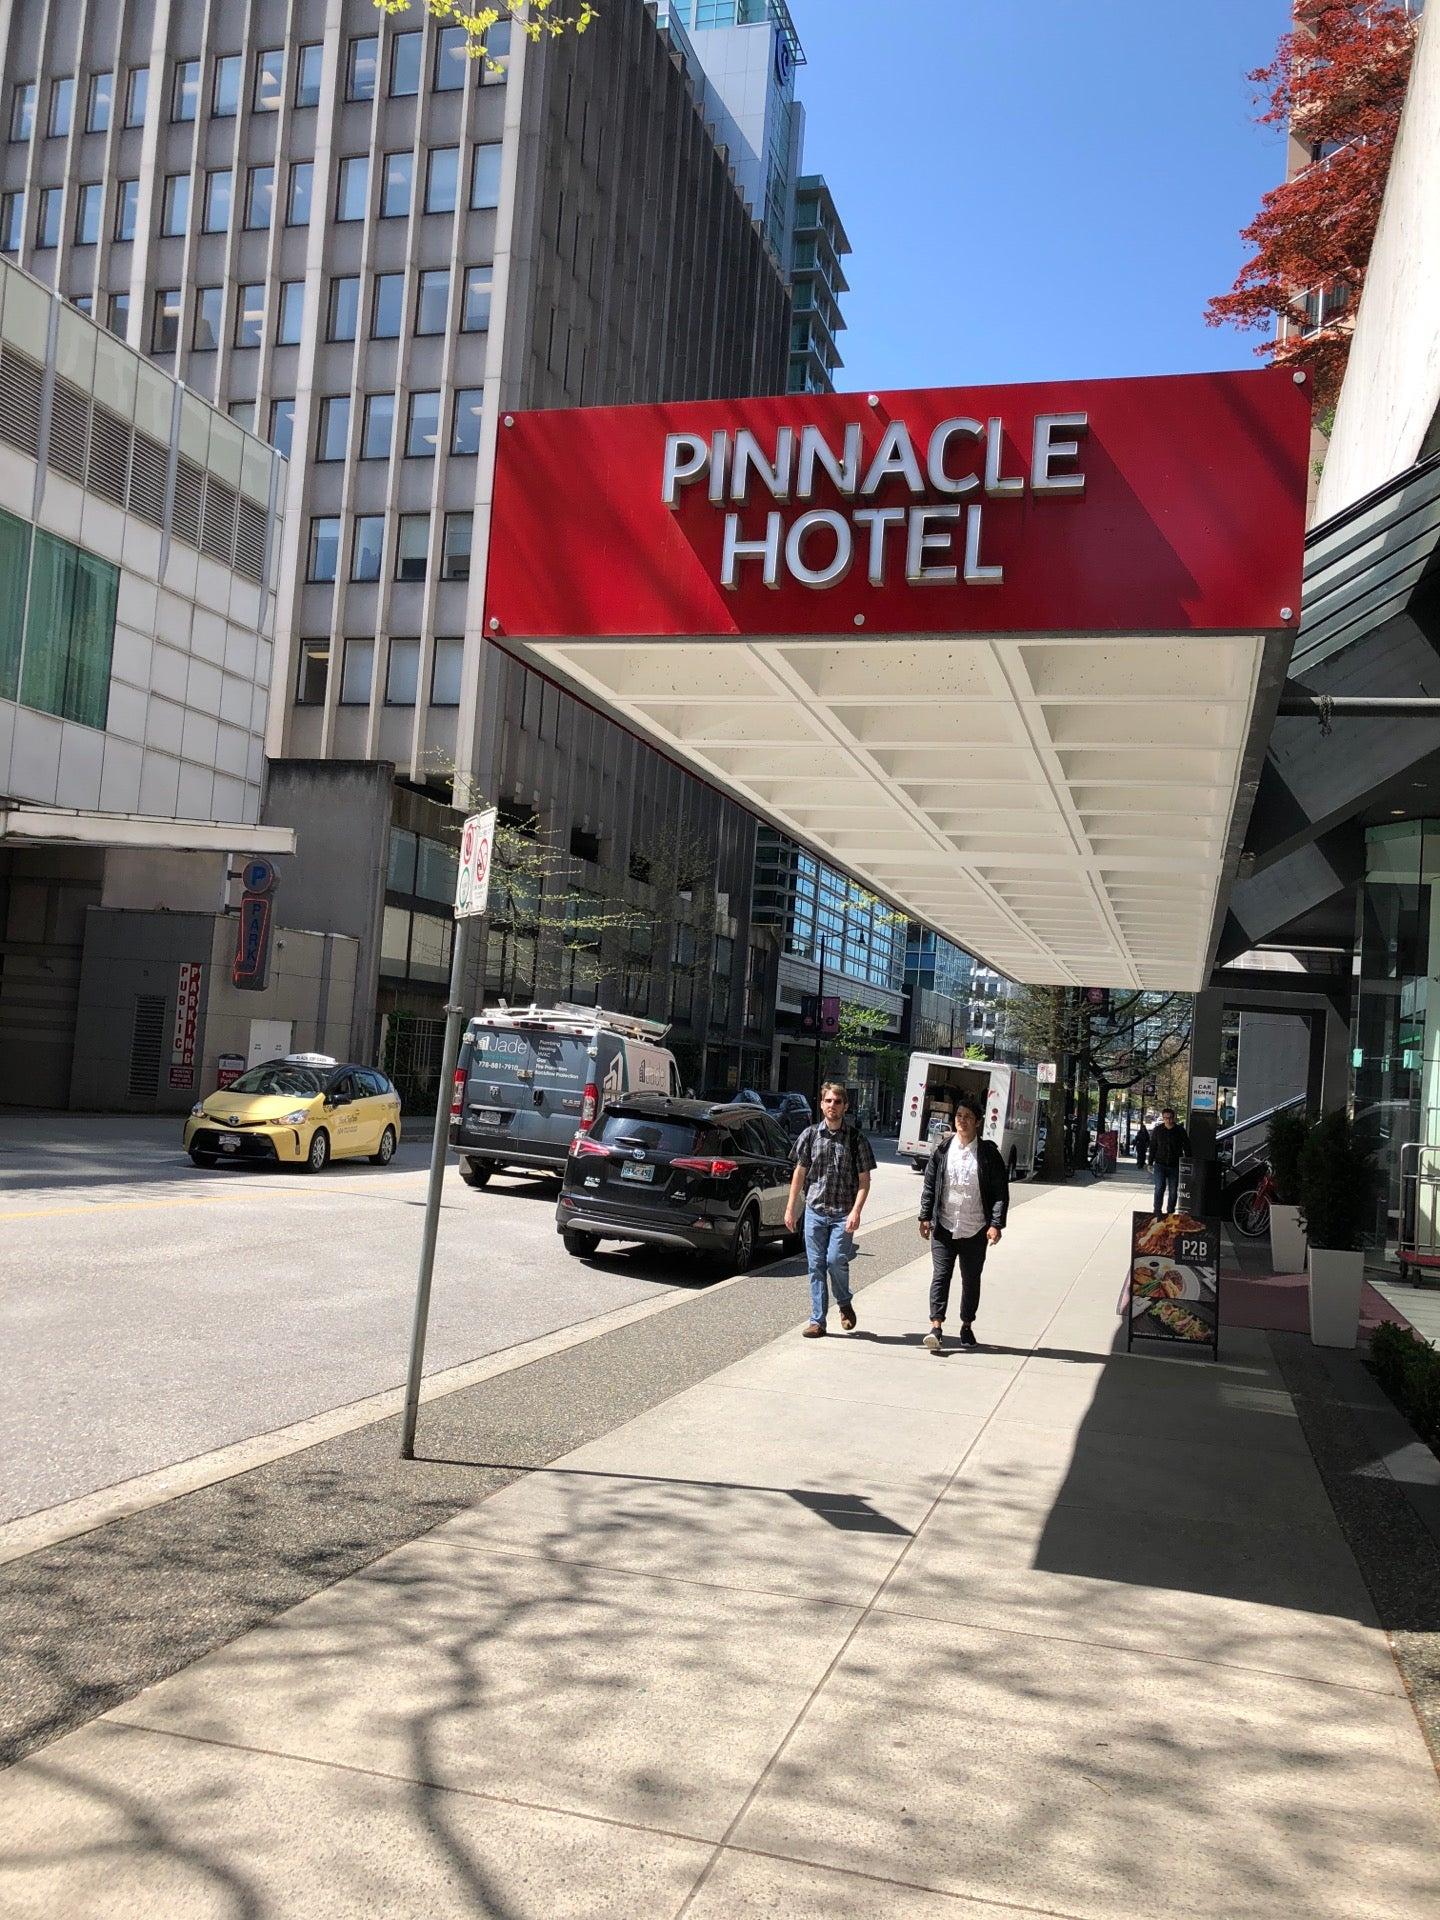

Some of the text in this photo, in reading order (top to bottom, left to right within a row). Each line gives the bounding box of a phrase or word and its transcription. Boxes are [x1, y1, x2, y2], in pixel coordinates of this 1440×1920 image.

[661, 411, 1088, 509] PINNACLE
[720, 503, 1003, 591] HOTEL
[251, 865, 267, 886] P
[246, 903, 262, 962] PARK
[175, 966, 189, 1049] PUBLIC
[183, 966, 199, 1065] PARKING
[489, 1038, 527, 1055] Jade
[1225, 1108, 1235, 1121] P
[1182, 1239, 1207, 1256] P2B
